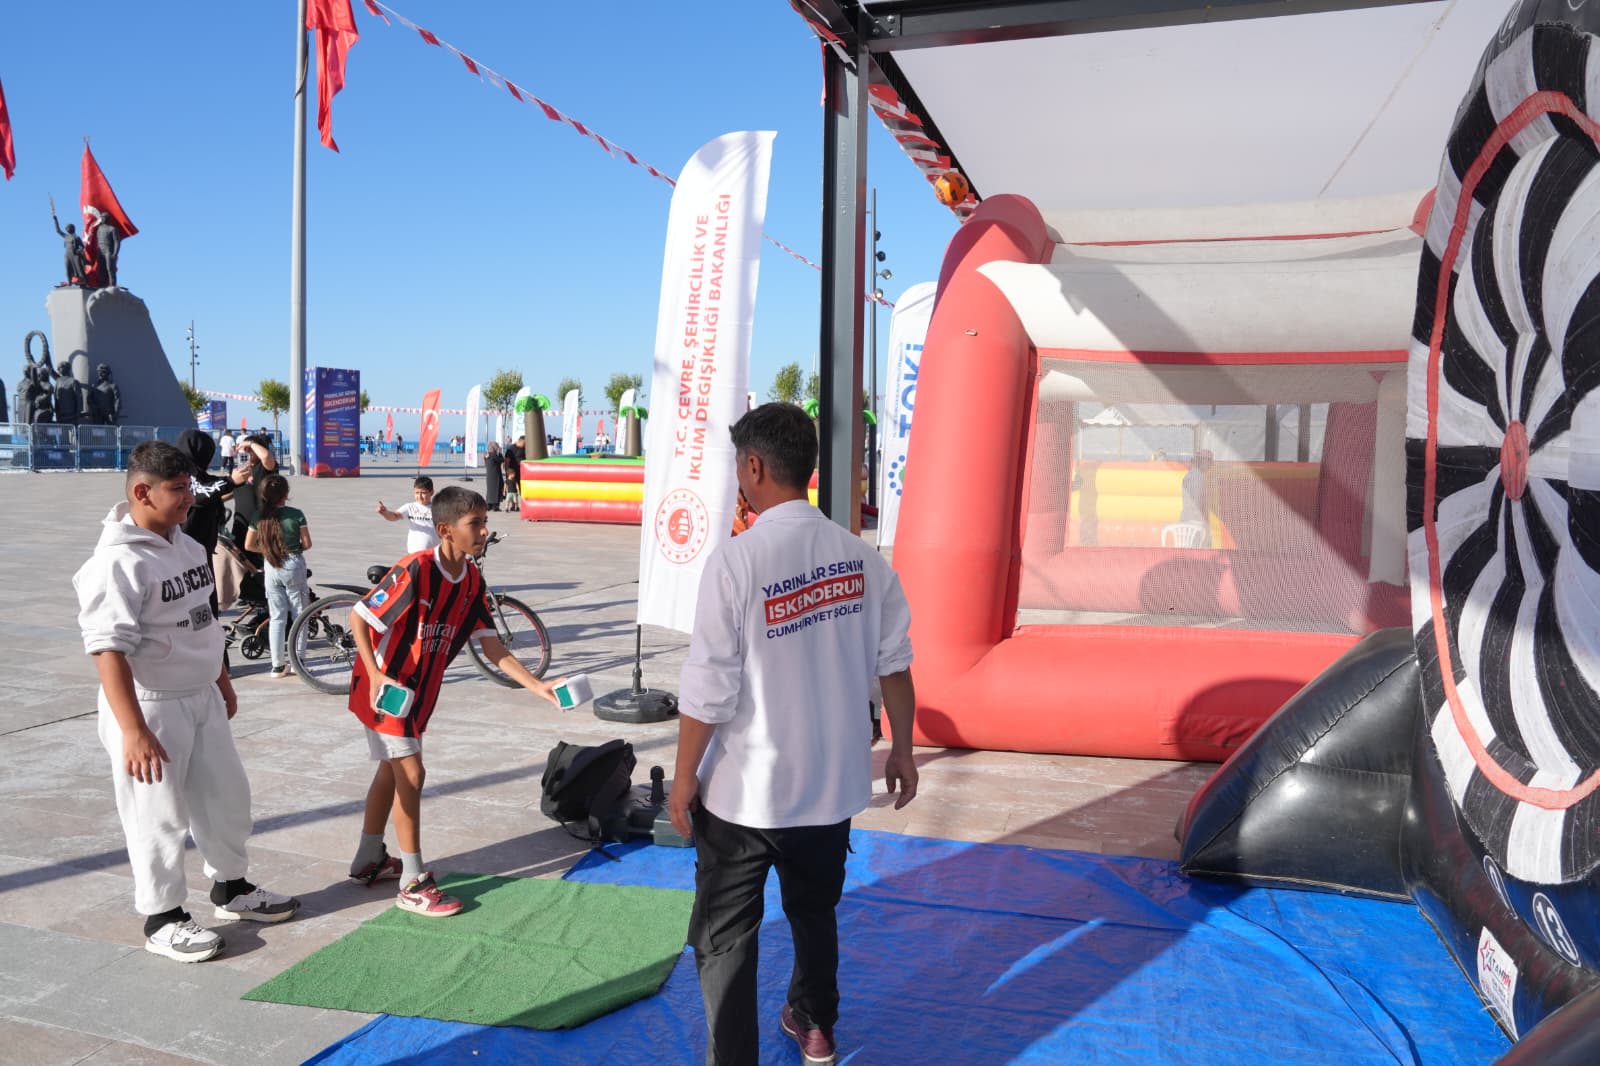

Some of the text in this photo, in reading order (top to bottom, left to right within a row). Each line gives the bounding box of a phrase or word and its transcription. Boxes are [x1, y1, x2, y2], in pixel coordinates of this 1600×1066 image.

[695, 215, 709, 239] VE
[708, 194, 731, 301] BAKANLIĞI
[678, 355, 696, 420] ÇEVRE,
[675, 426, 688, 458] T.C.
[161, 576, 185, 603] OLD
[762, 566, 826, 598] YARINLAR
[1535, 900, 1578, 961] 13
